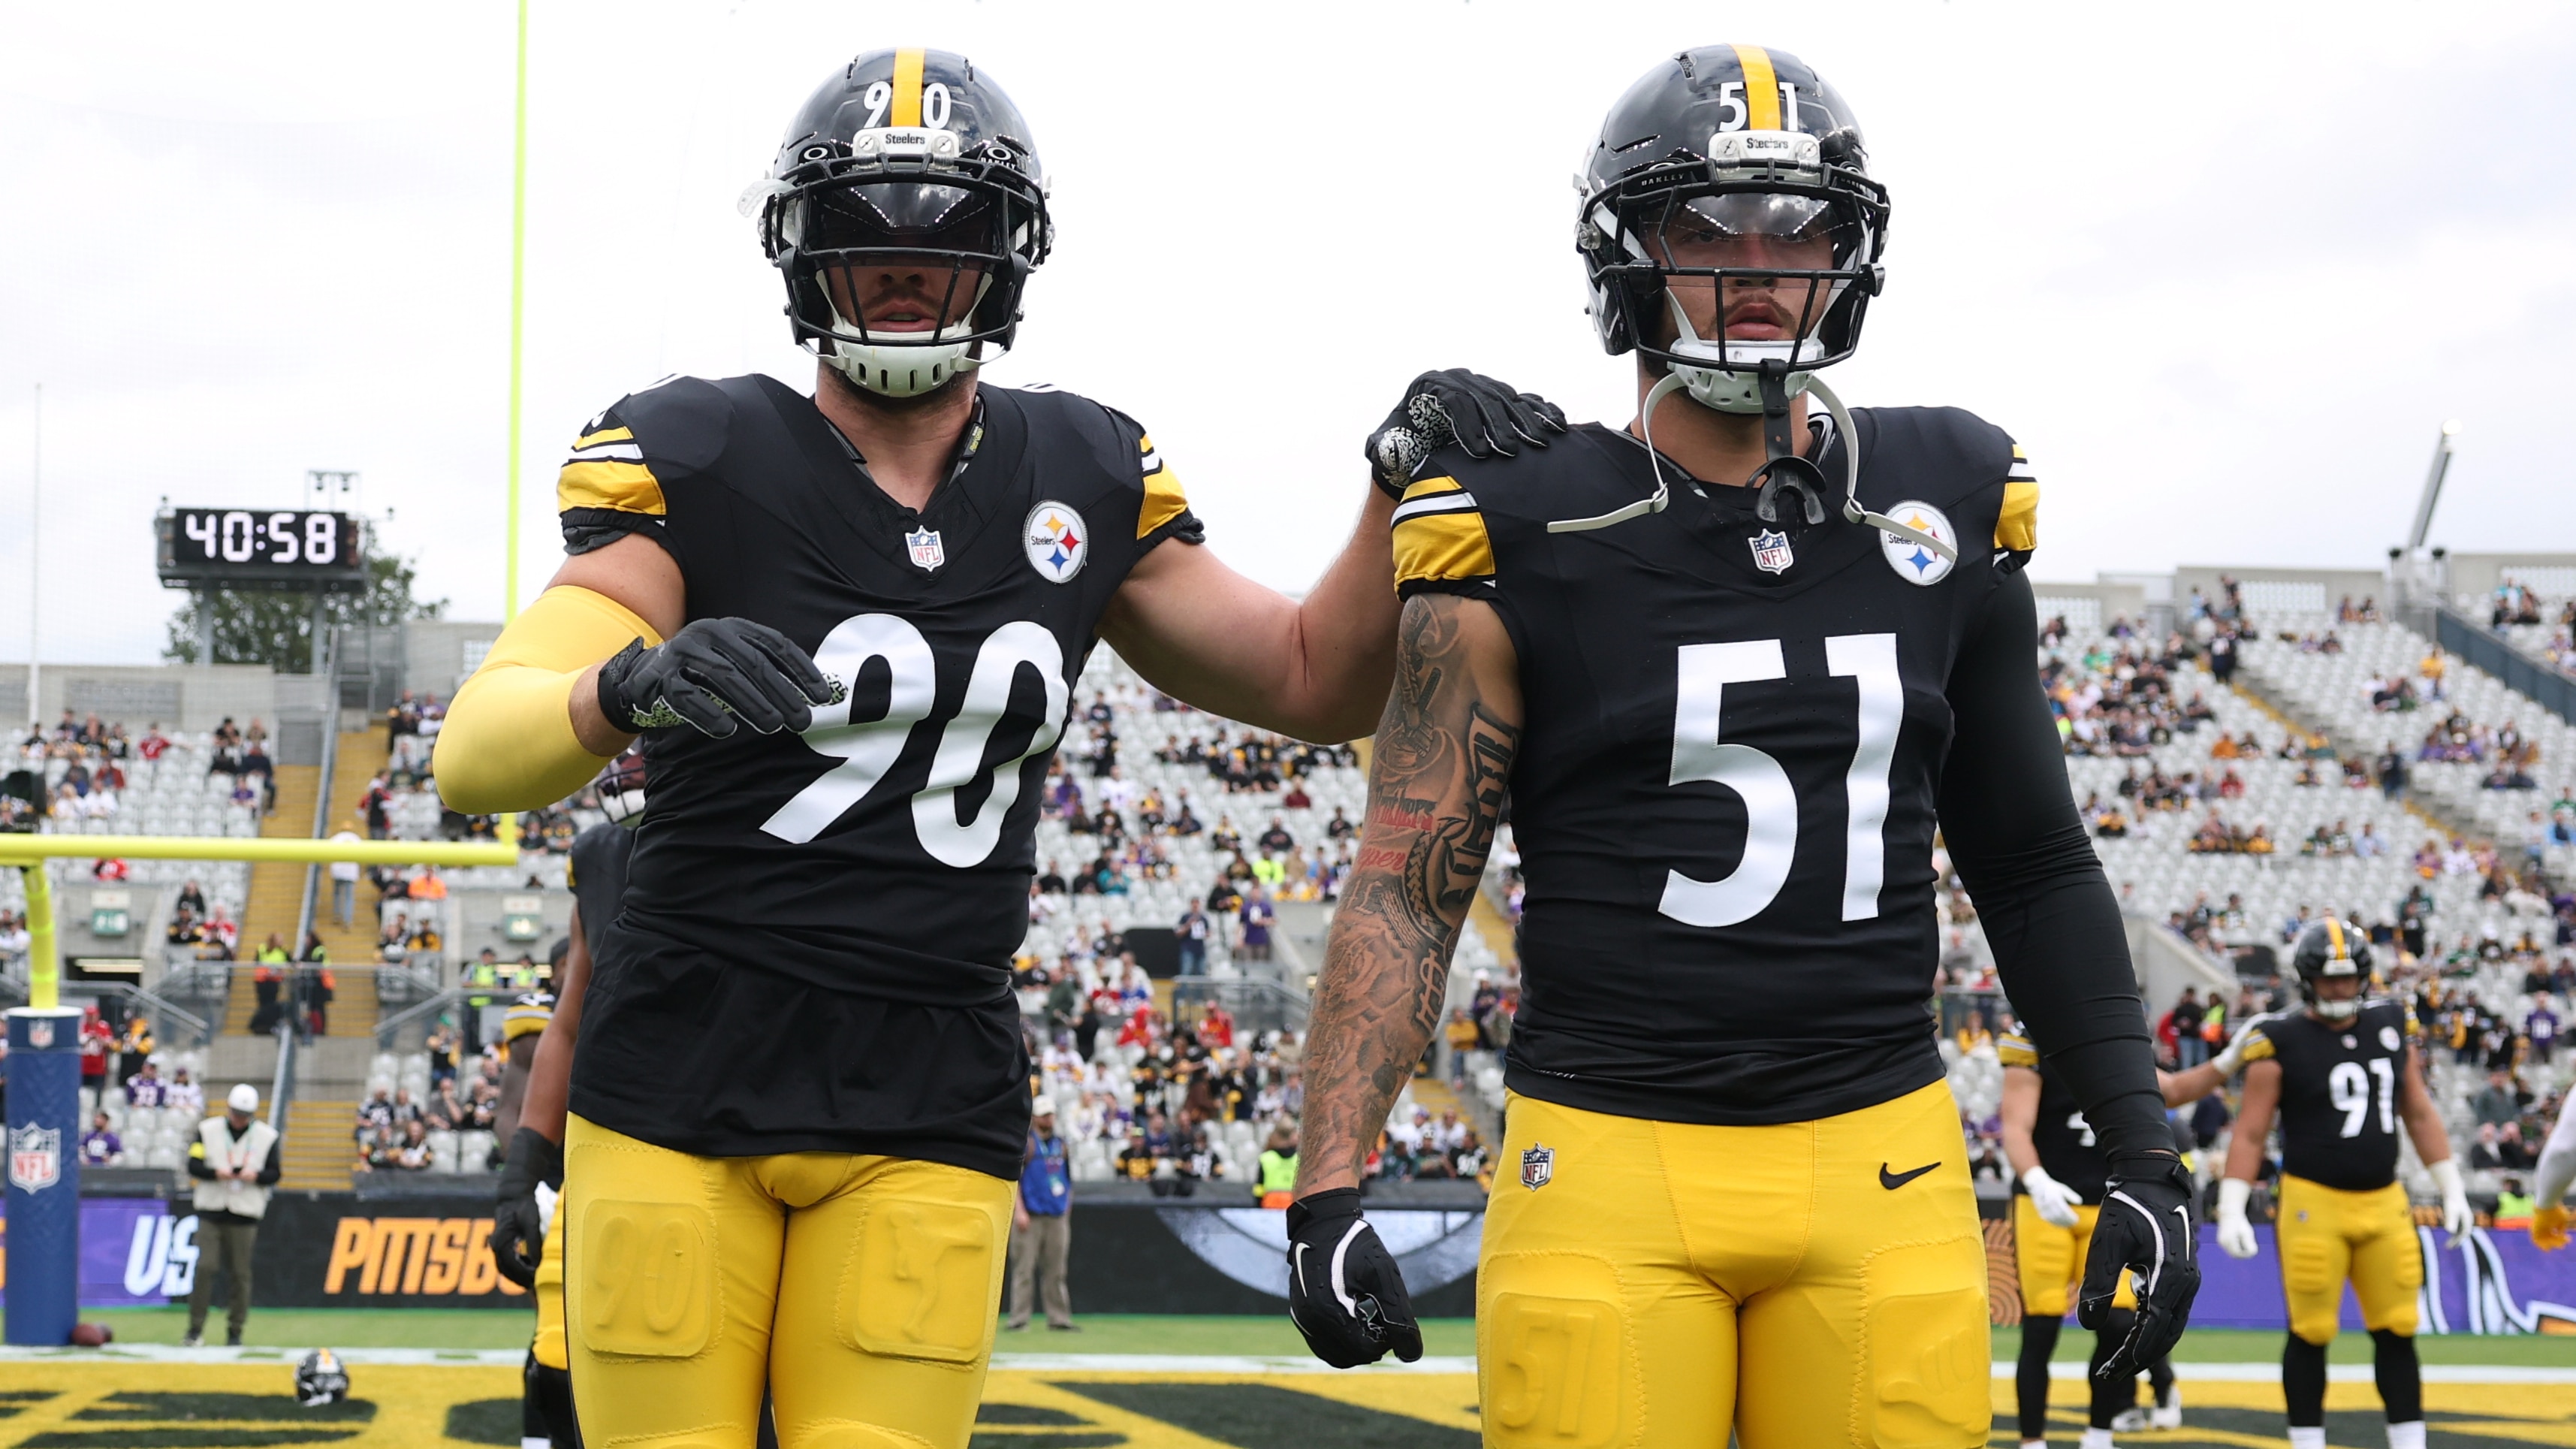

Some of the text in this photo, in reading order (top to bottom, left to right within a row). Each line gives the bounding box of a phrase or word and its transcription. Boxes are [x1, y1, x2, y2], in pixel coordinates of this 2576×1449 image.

[863, 80, 952, 129] 90
[1718, 81, 1800, 131] 51
[885, 133, 925, 145] Steelers
[1641, 173, 1685, 186] OAKLEY
[185, 512, 337, 564] 40:58
[915, 547, 940, 563] NFL
[1030, 535, 1056, 545] Steelers
[1760, 548, 1787, 566] NFL
[760, 613, 1070, 869] 90
[1658, 633, 1904, 928] 51
[2328, 1057, 2396, 1140] 91
[13, 1152, 54, 1181] NFL
[1525, 1164, 1545, 1182] NFL
[324, 1217, 527, 1295] PITTSB
[595, 1215, 695, 1334] 90
[1497, 1307, 1595, 1438] 51
